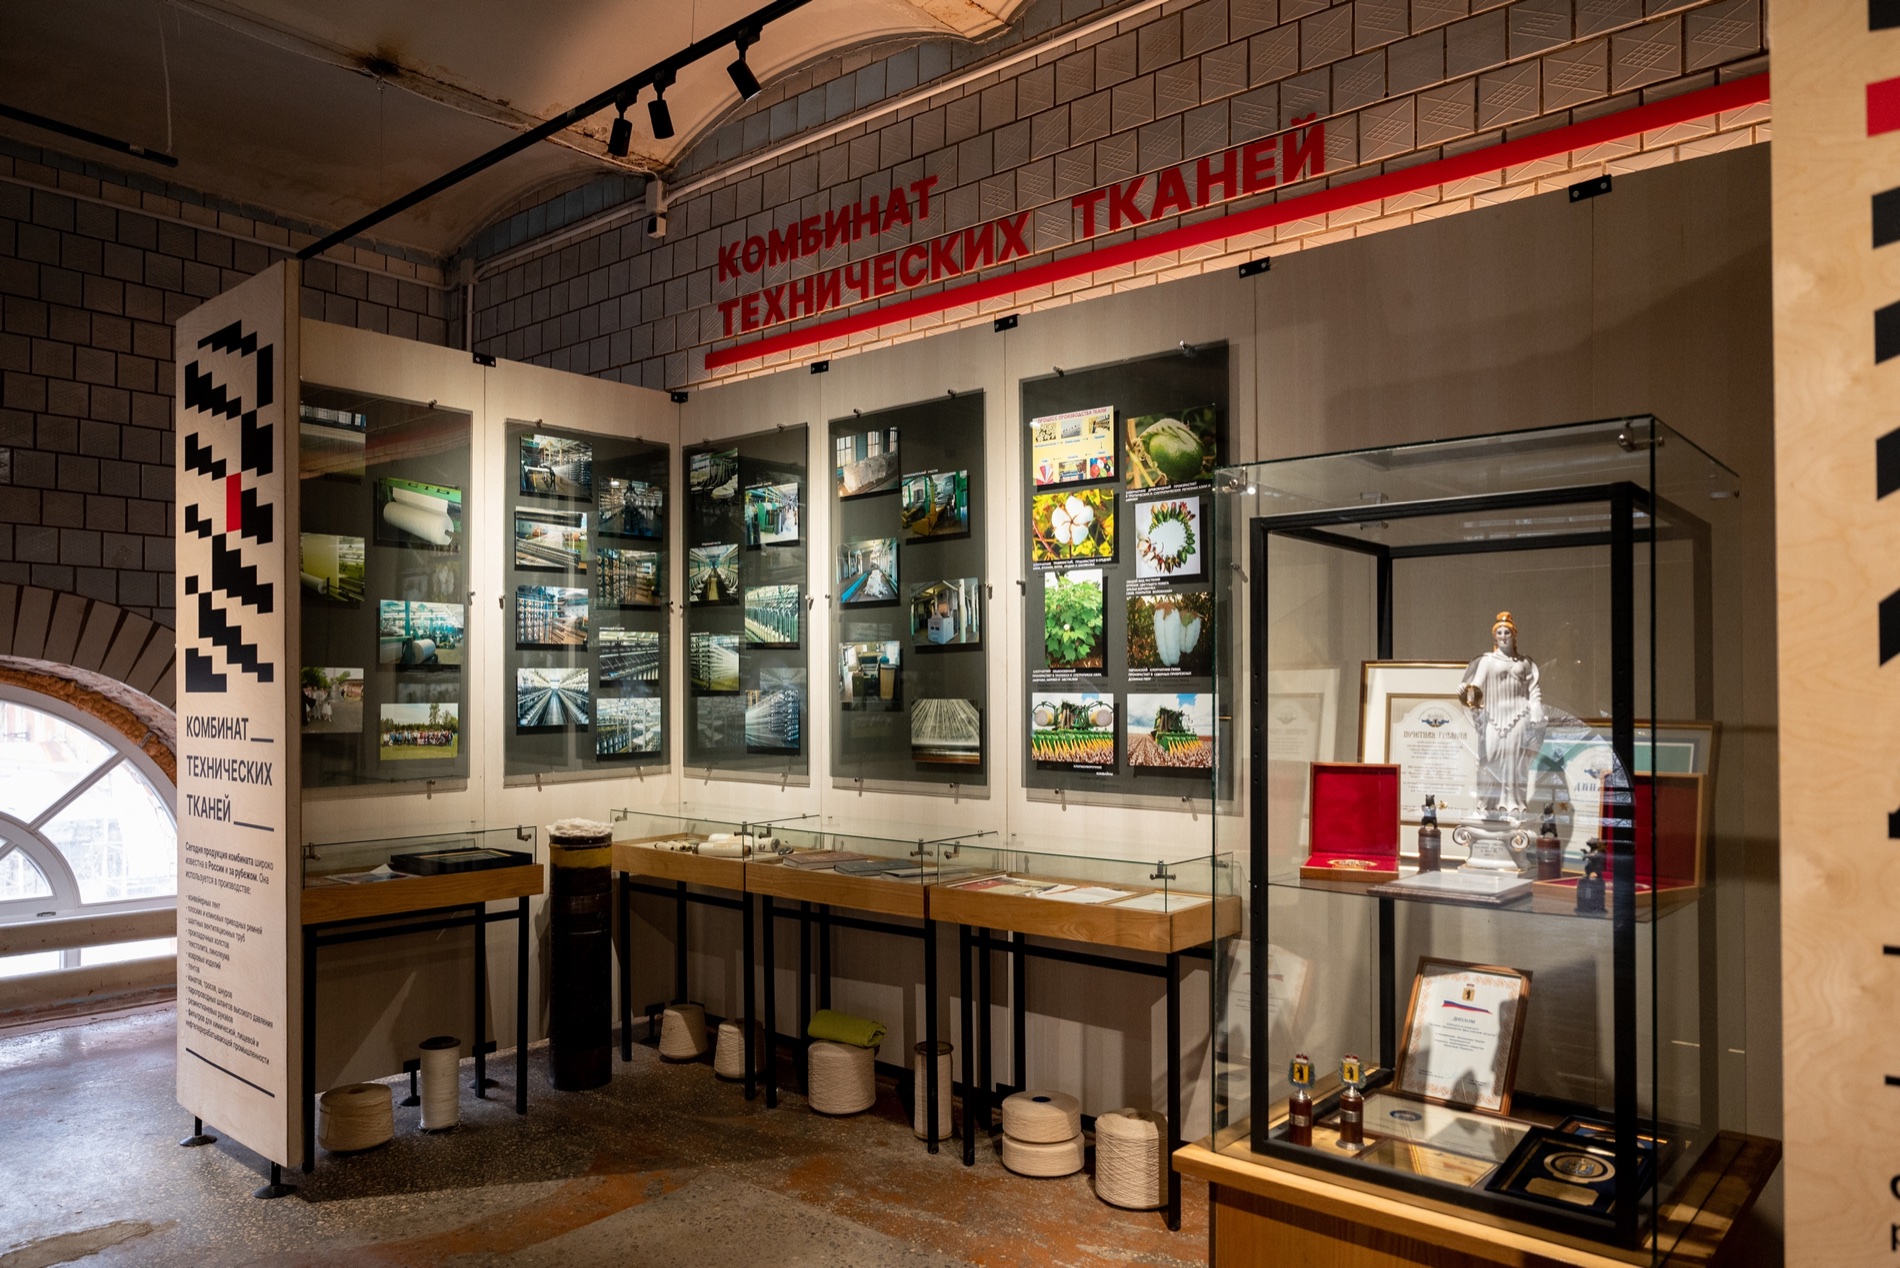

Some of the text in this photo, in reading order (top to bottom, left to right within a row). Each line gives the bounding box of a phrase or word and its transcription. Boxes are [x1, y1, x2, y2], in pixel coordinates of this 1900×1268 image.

[718, 112, 1326, 337] ТЕХНИЧЕСКИХ ТКАНЕЙ
[718, 174, 938, 283] КОМБИНАТ
[186, 716, 249, 741] КОМБИНАТ
[186, 755, 272, 786] ТЕХНИЧЕСКИХ
[186, 794, 231, 822] ТКАНЕЙ
[185, 842, 274, 871] Сегодня продукция комбината широко
[185, 857, 204, 868] известна
[208, 861, 224, 873] России
[229, 868, 234, 876] за
[235, 867, 258, 882] рубежом.
[259, 873, 269, 884] Она
[185, 871, 214, 884] используется
[218, 879, 251, 895] производстве:
